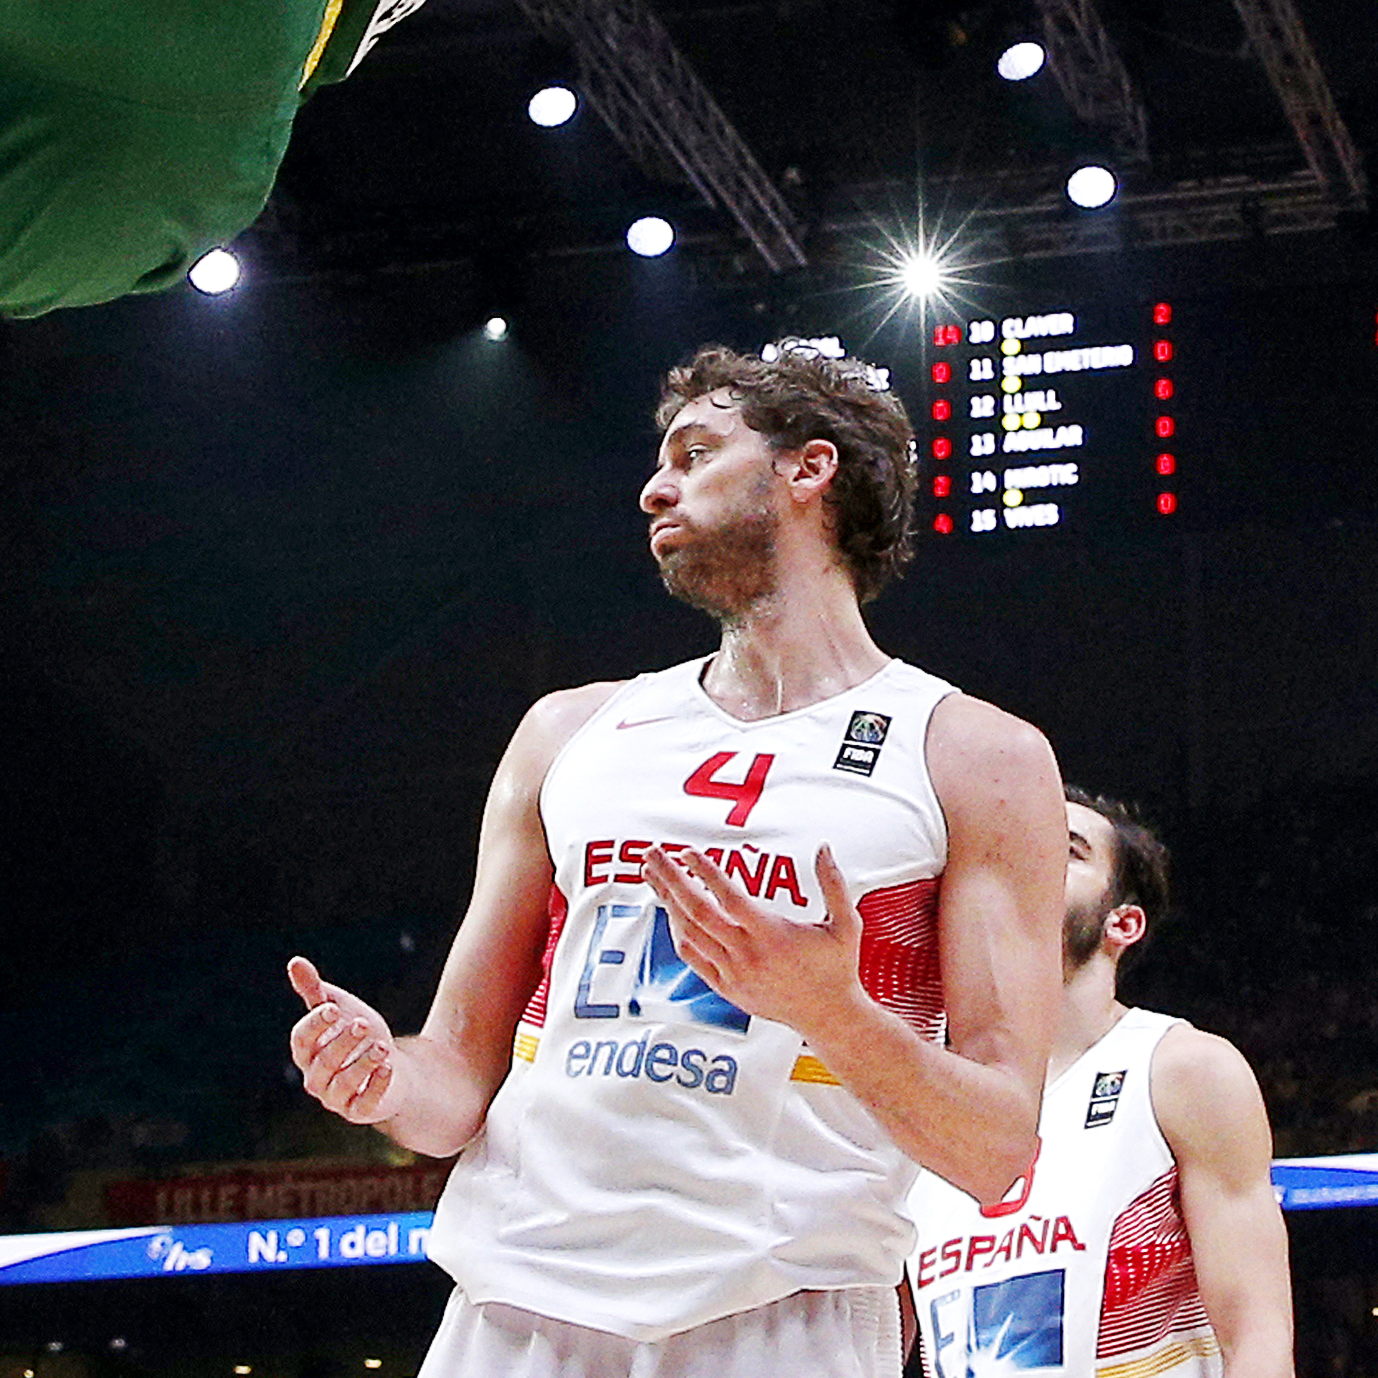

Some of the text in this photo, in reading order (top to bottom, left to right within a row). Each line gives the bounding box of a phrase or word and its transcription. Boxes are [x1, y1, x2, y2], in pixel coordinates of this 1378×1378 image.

[683, 751, 775, 828] 4
[566, 1030, 740, 1096] endesa
[313, 1227, 331, 1260] 1
[339, 1221, 400, 1259] del
[918, 1214, 1086, 1289] ESPAÑA
